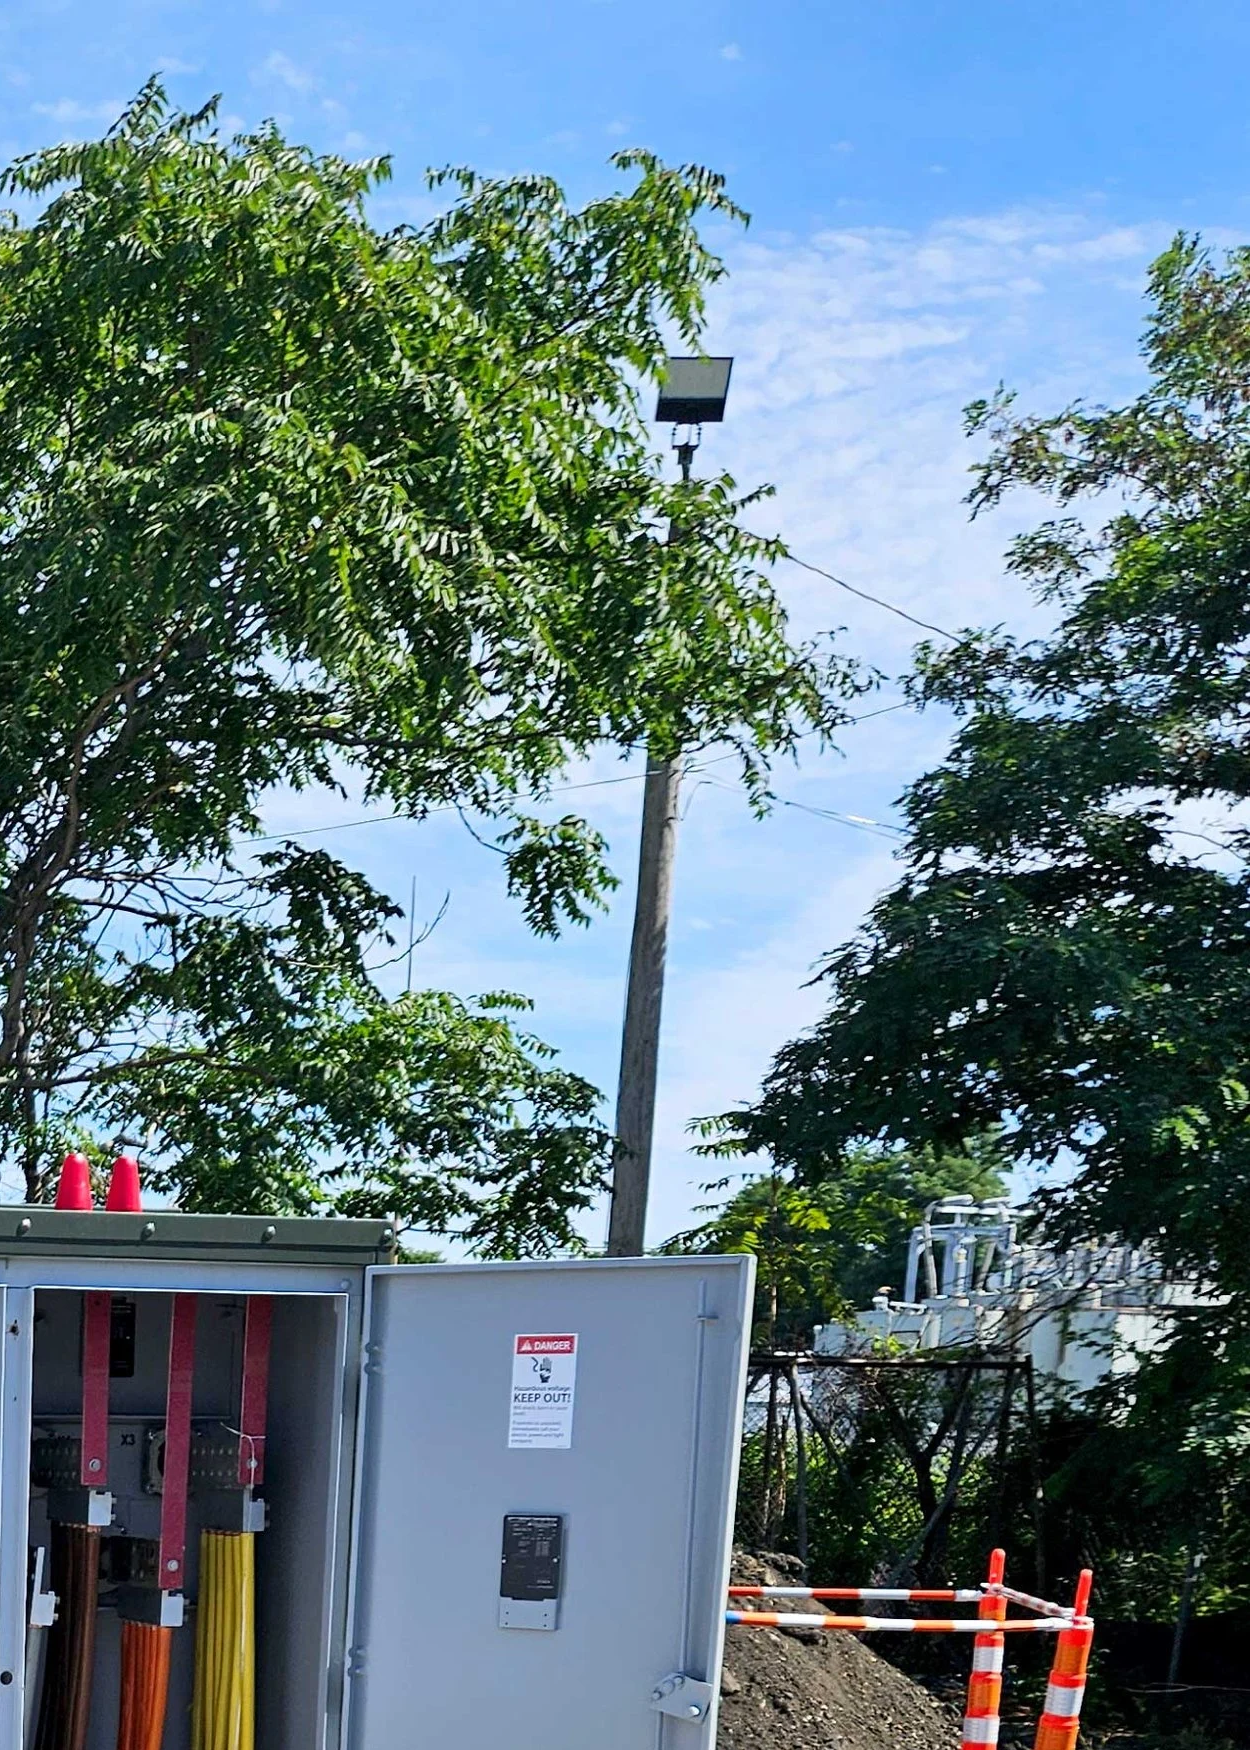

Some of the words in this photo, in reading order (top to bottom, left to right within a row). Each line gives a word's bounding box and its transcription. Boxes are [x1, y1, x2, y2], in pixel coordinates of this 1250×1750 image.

[533, 1341, 571, 1351] DANGER
[513, 1393, 541, 1403] KEEP
[543, 1393, 571, 1403] OUT!
[120, 1434, 135, 1446] X3
